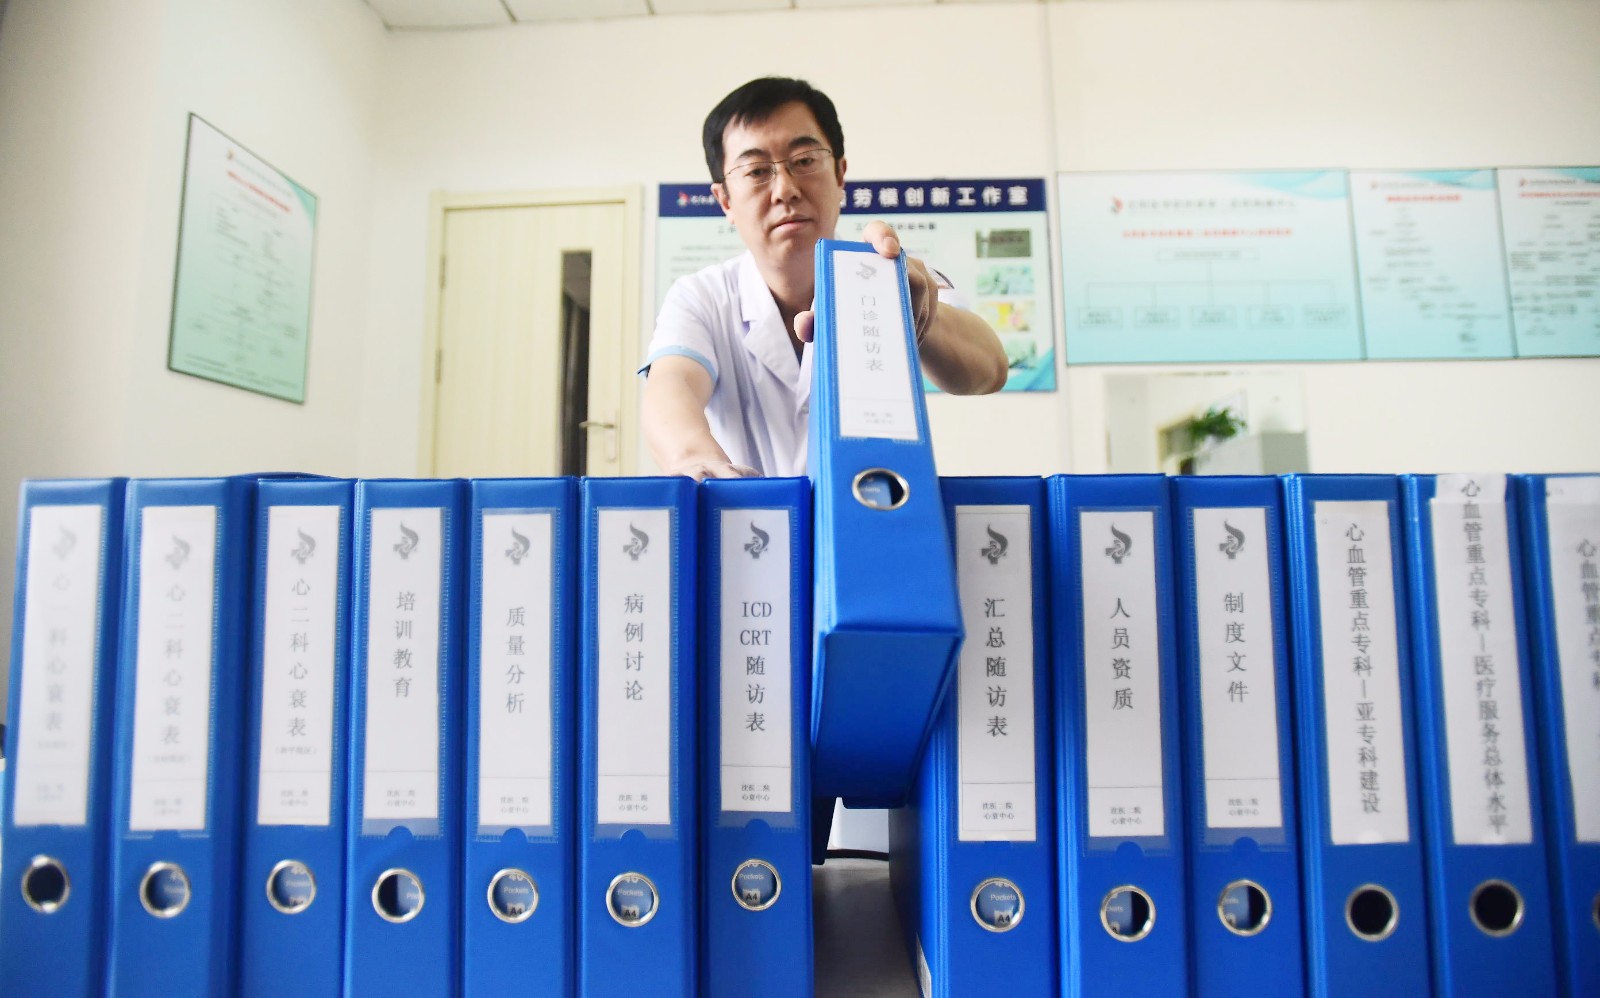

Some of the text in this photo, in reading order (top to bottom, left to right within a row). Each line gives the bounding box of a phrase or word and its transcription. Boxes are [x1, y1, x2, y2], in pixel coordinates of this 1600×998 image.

[861, 295, 884, 373] 门诊随访表
[393, 591, 416, 699] 培训教育
[624, 592, 645, 702] 病例讨论
[739, 629, 772, 646] CRT
[741, 601, 772, 618] ICD
[161, 583, 187, 745] 心二科心衰表
[287, 578, 311, 737] 心二科心衰表
[506, 606, 527, 714] 质量分析
[984, 597, 1008, 738] 汇总随访表
[1109, 597, 1134, 711] 人员资质
[1224, 592, 1249, 704] 制度文件
[745, 656, 767, 732] 随访表
[503, 886, 530, 895] Pockets
[617, 888, 644, 897] Pockets
[623, 909, 637, 918] A4
[738, 872, 766, 881] Pockets
[745, 893, 758, 902] A4
[990, 894, 1018, 903] Pockets
[997, 914, 1011, 924] A4
